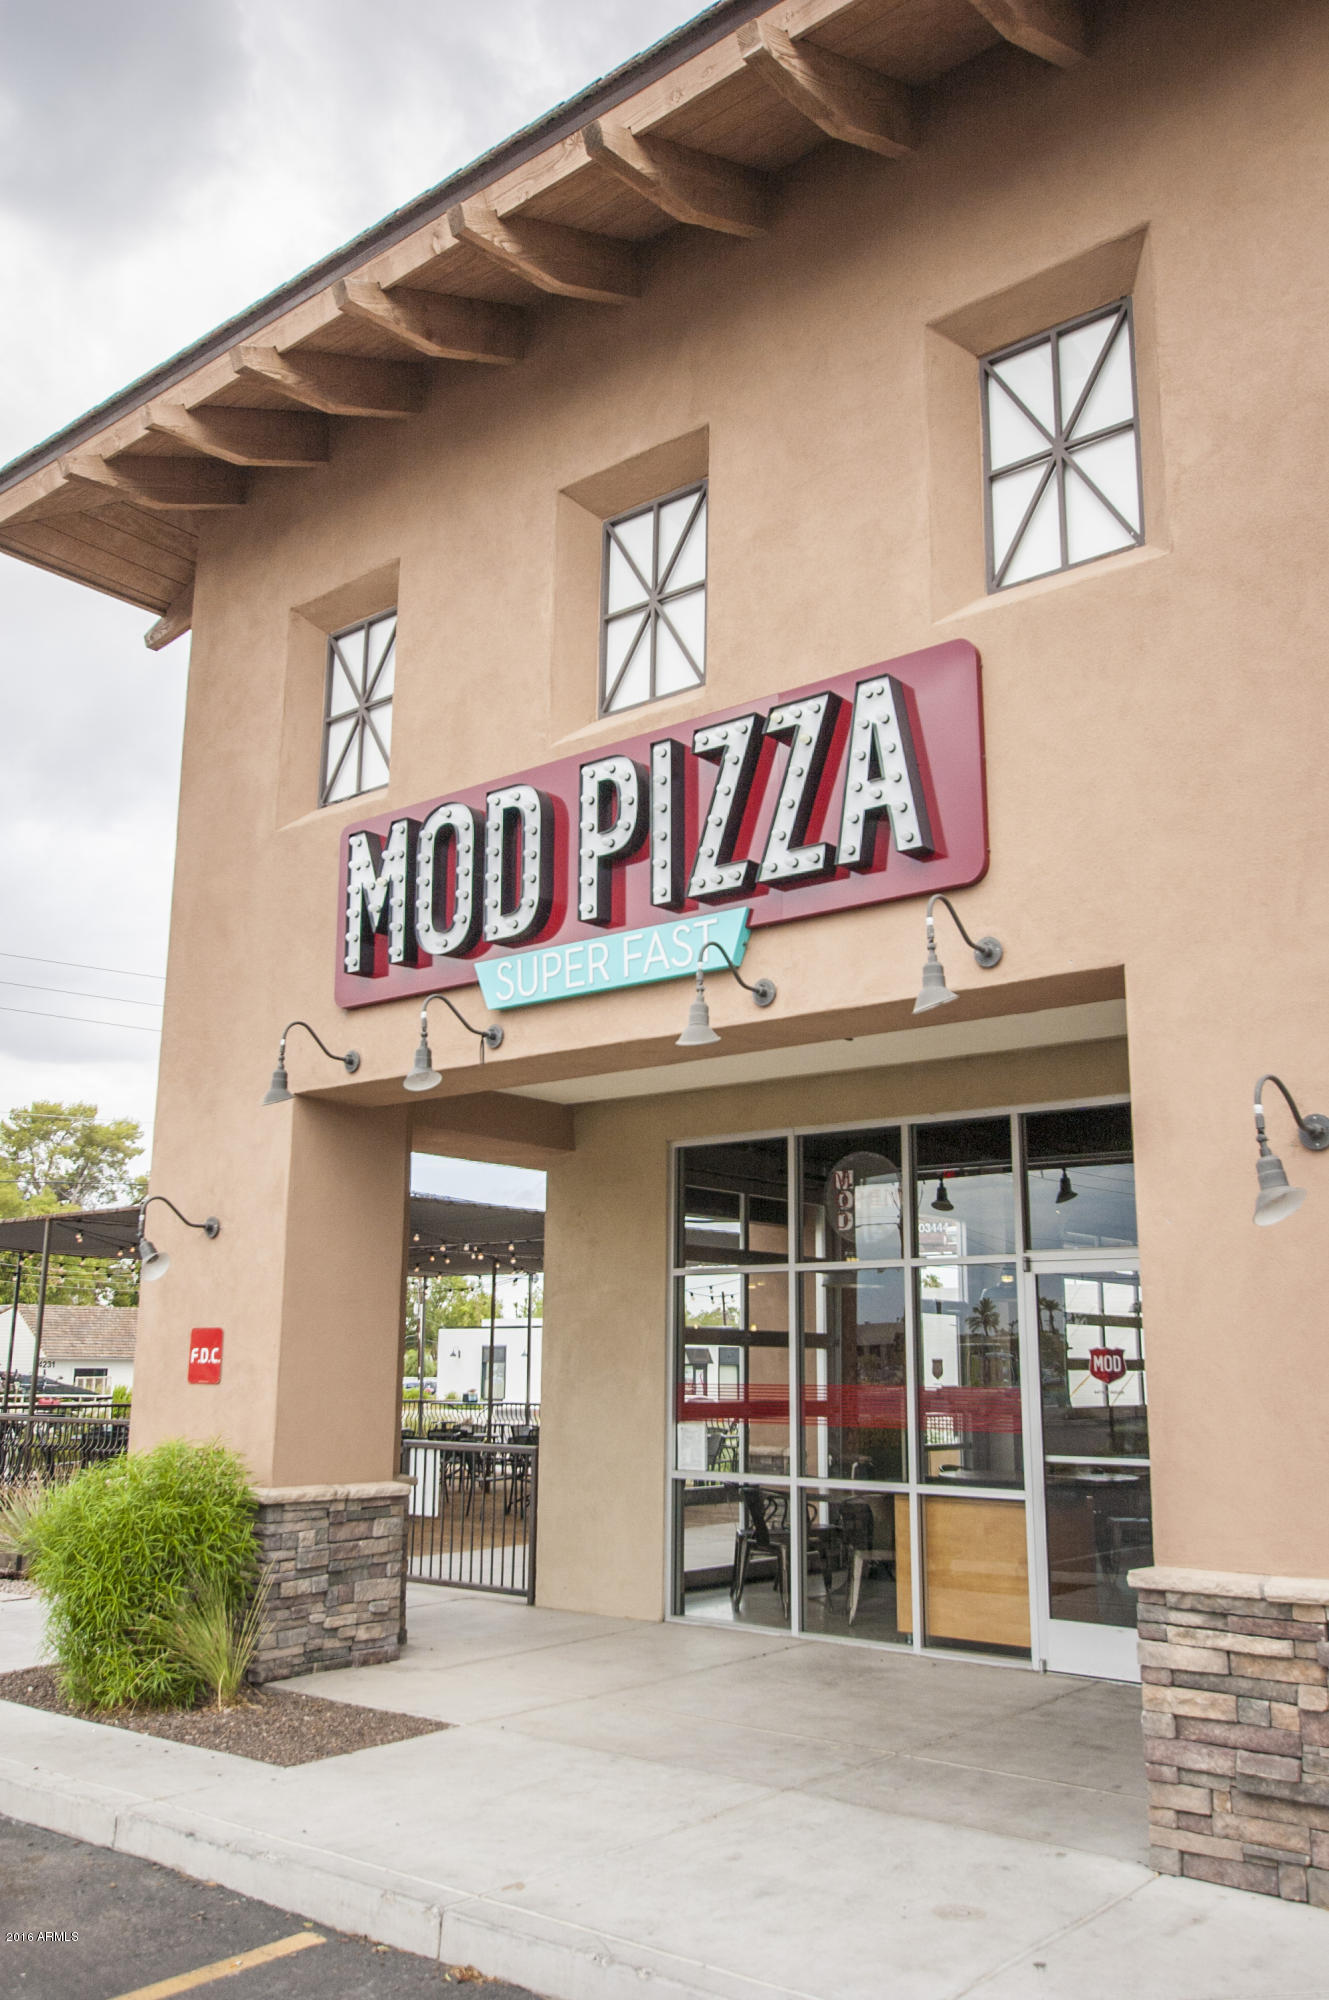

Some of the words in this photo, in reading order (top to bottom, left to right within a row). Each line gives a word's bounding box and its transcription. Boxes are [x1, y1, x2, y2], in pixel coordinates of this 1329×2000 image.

[344, 783, 554, 978] MOD
[577, 673, 933, 928] PIZZA
[496, 942, 610, 1001] SUPER
[622, 917, 718, 978] FAST
[1093, 1354, 1122, 1372] MOD
